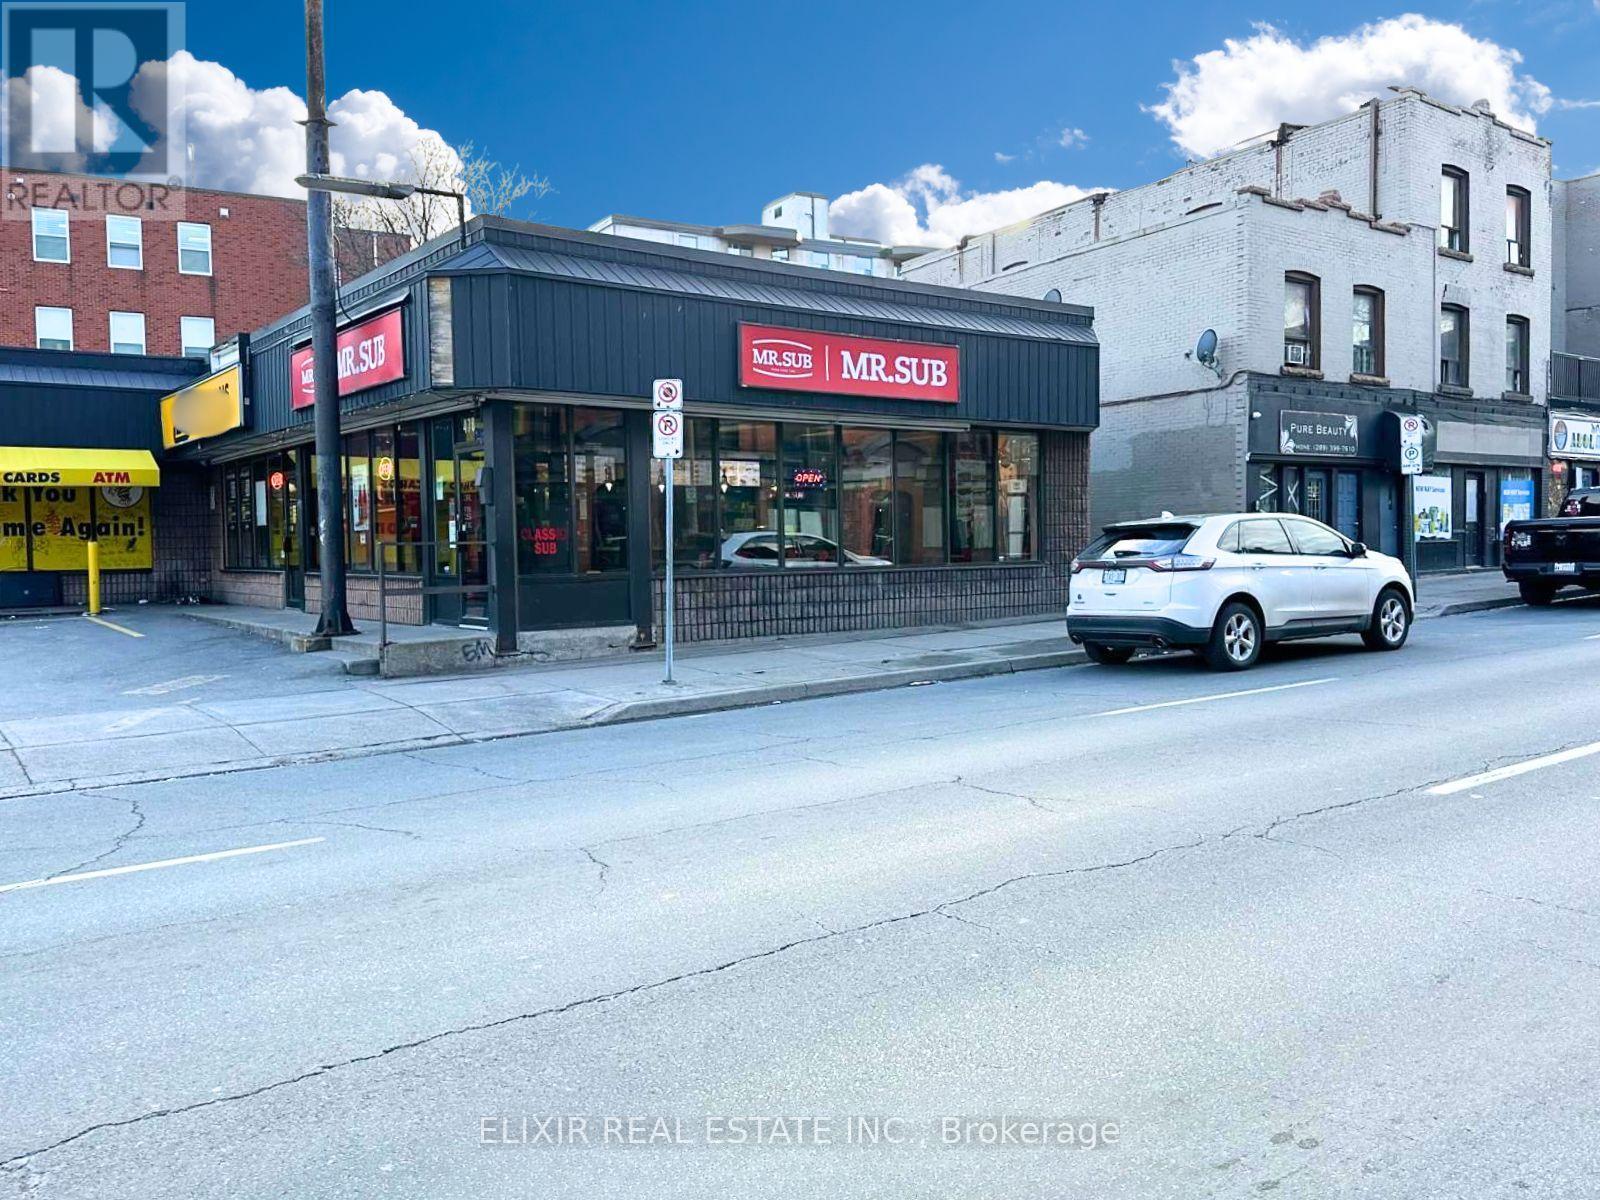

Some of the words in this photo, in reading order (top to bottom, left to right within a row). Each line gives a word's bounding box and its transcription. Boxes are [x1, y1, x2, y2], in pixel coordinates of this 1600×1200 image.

[752, 348, 813, 369] MR.SUB
[840, 350, 948, 387] MR.SUB
[1290, 423, 1314, 434] PURE
[1316, 424, 1348, 437] BEAUTY
[3, 472, 61, 483] CARDS
[93, 472, 131, 483] ATM
[794, 473, 824, 483] OPEN
[60, 515, 144, 540] Again!
[534, 541, 557, 555] SUB
